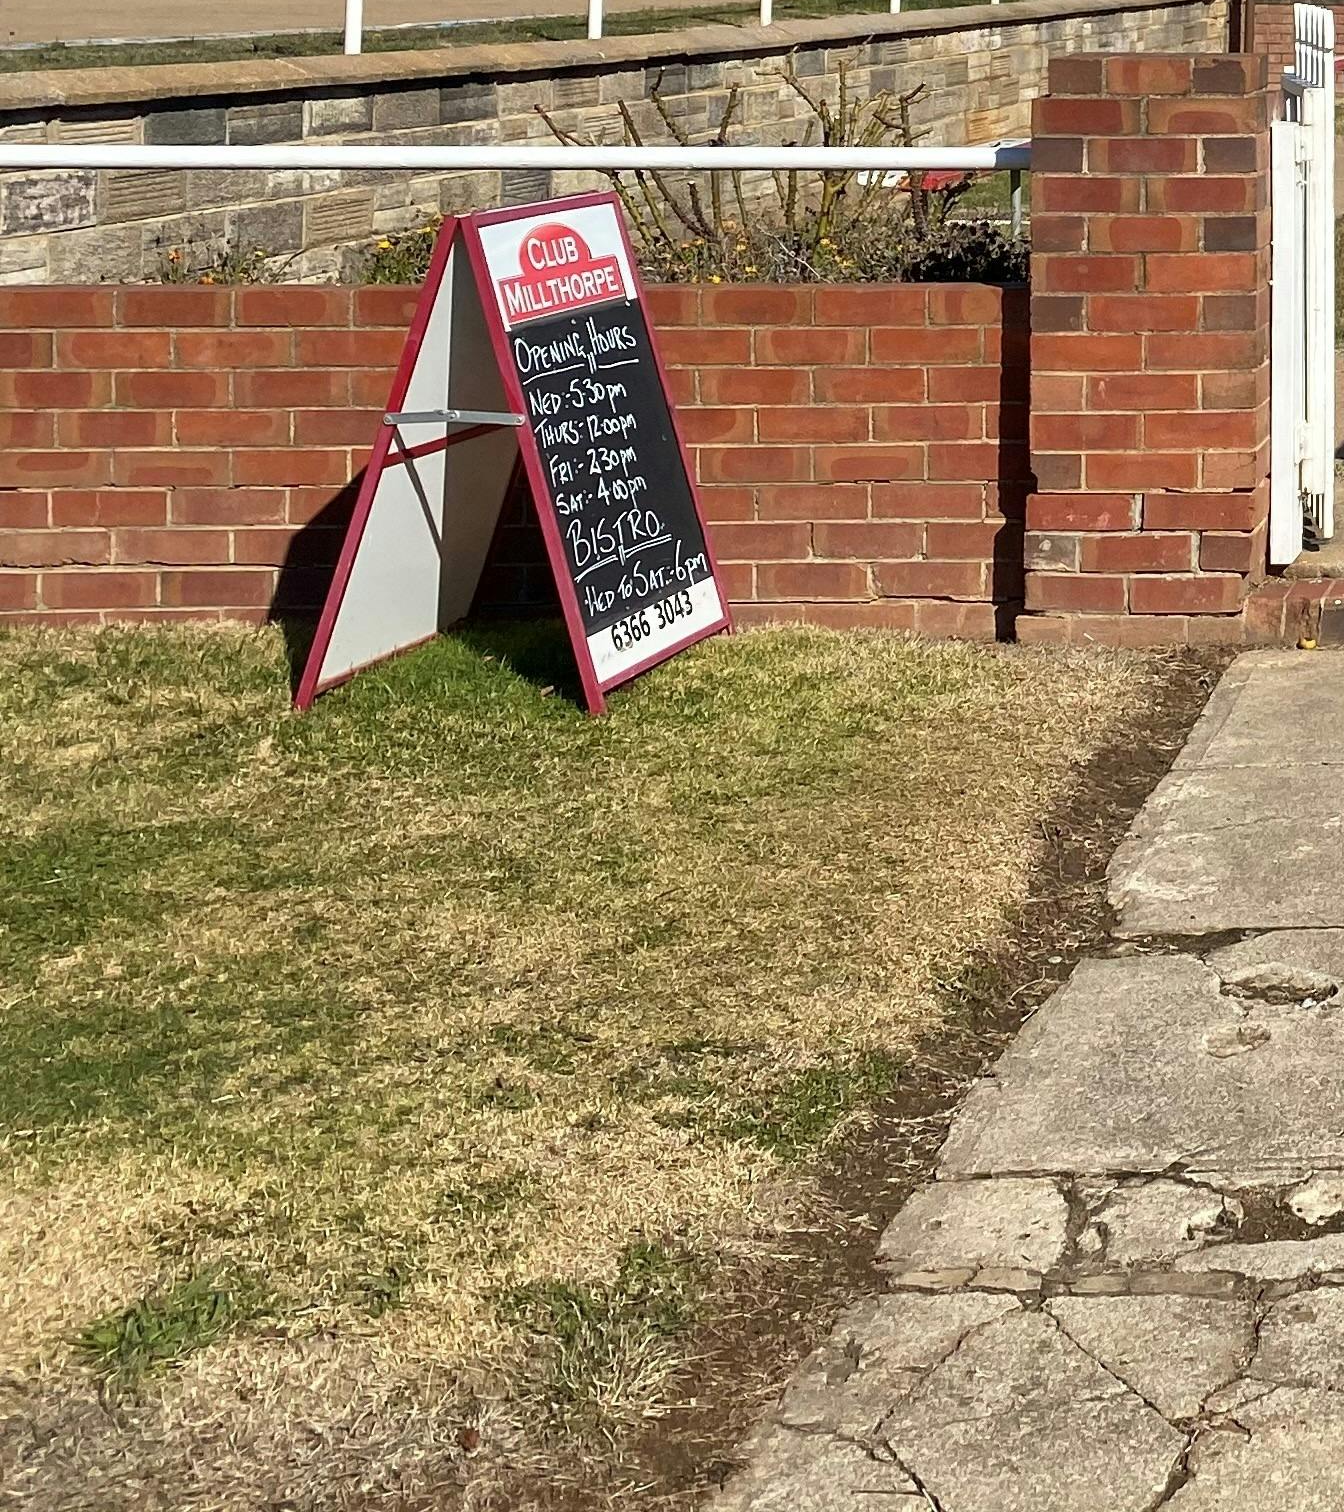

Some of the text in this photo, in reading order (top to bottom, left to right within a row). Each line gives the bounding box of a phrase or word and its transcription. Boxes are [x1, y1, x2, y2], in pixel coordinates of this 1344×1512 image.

[527, 236, 579, 270] CLUB
[504, 265, 620, 316] MILLTHORPE
[514, 317, 637, 372] OPENING HOURS
[611, 590, 693, 651] 6366 3043
